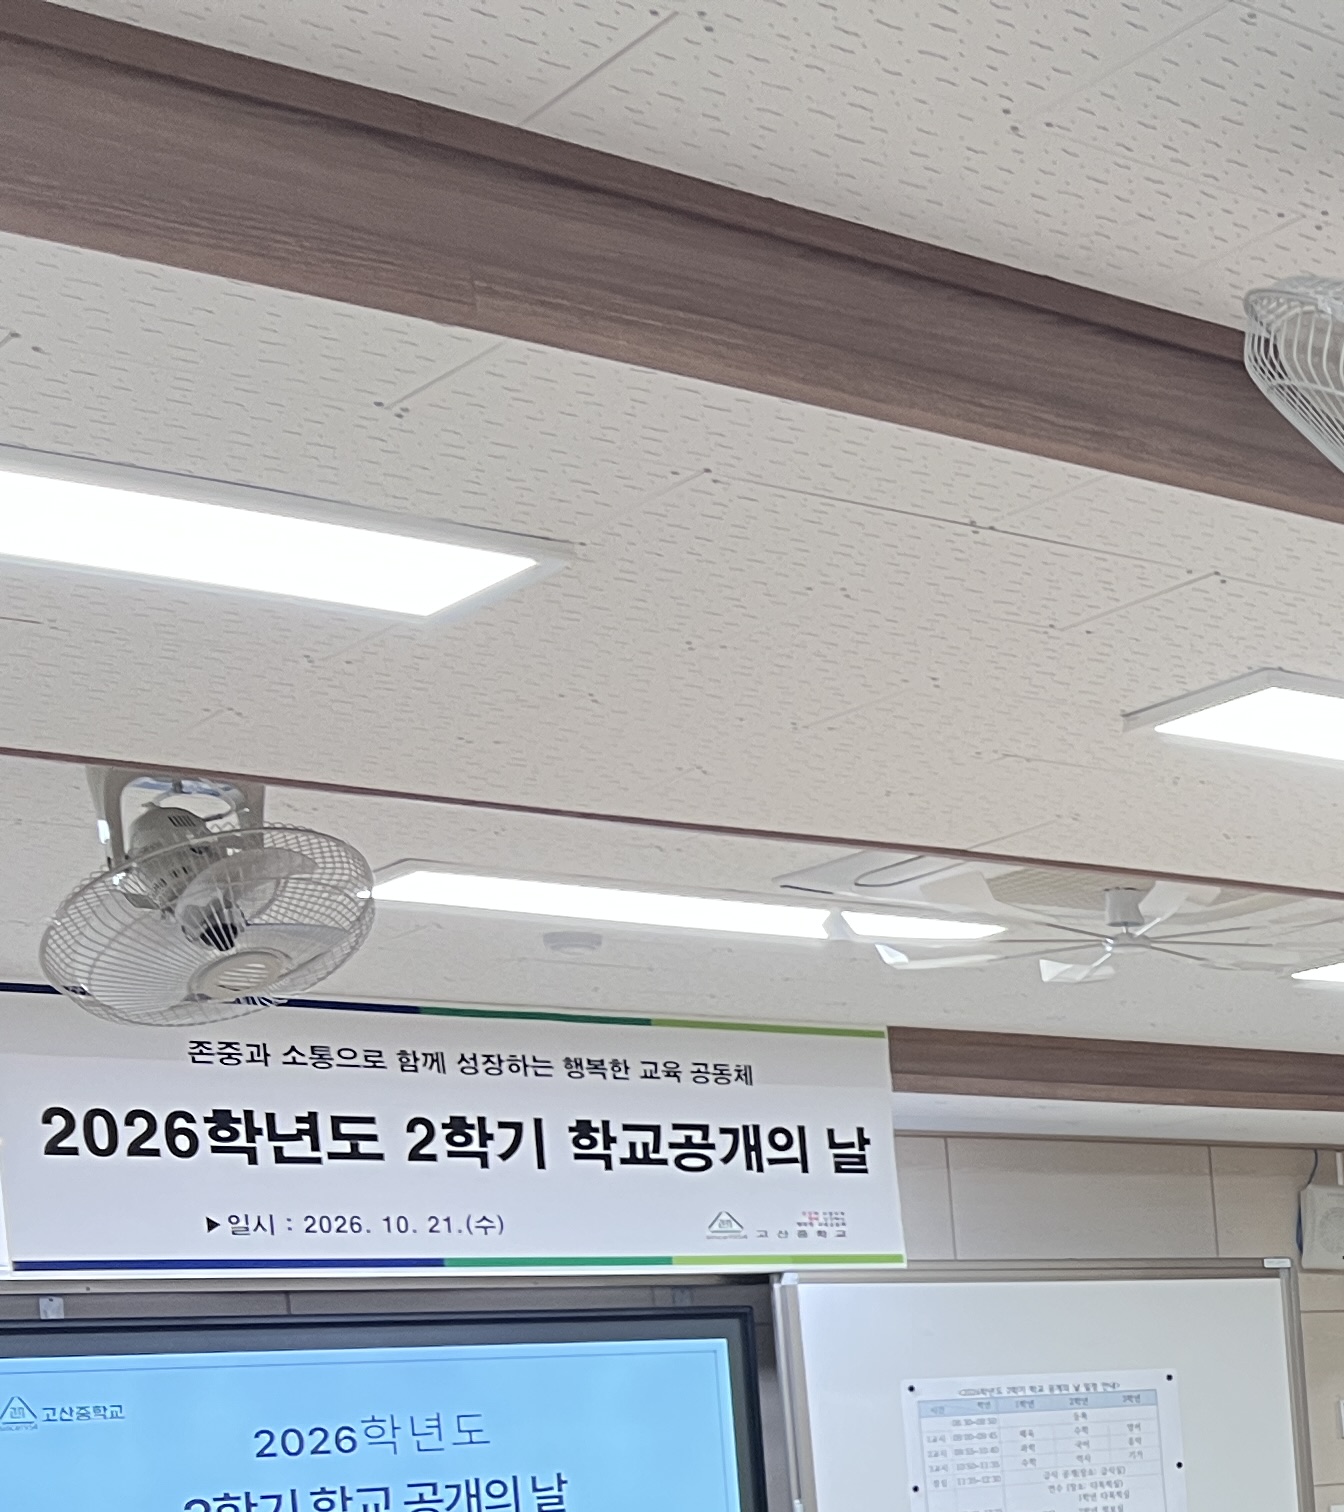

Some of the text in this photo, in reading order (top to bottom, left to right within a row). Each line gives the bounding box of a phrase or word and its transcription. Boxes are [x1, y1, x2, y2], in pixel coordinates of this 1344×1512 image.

[187, 1040, 754, 1086] 존중과 소통으로 함께 성장하는 행복한 교육 공동체
[42, 1107, 871, 1174] 2026학년도 2학기 학교공개의 날
[228, 1214, 275, 1236] 일시
[304, 1215, 371, 1234] 2026.
[382, 1216, 417, 1234] 10.
[428, 1214, 505, 1236] 21.(수)
[42, 1404, 125, 1423] 고산중학교
